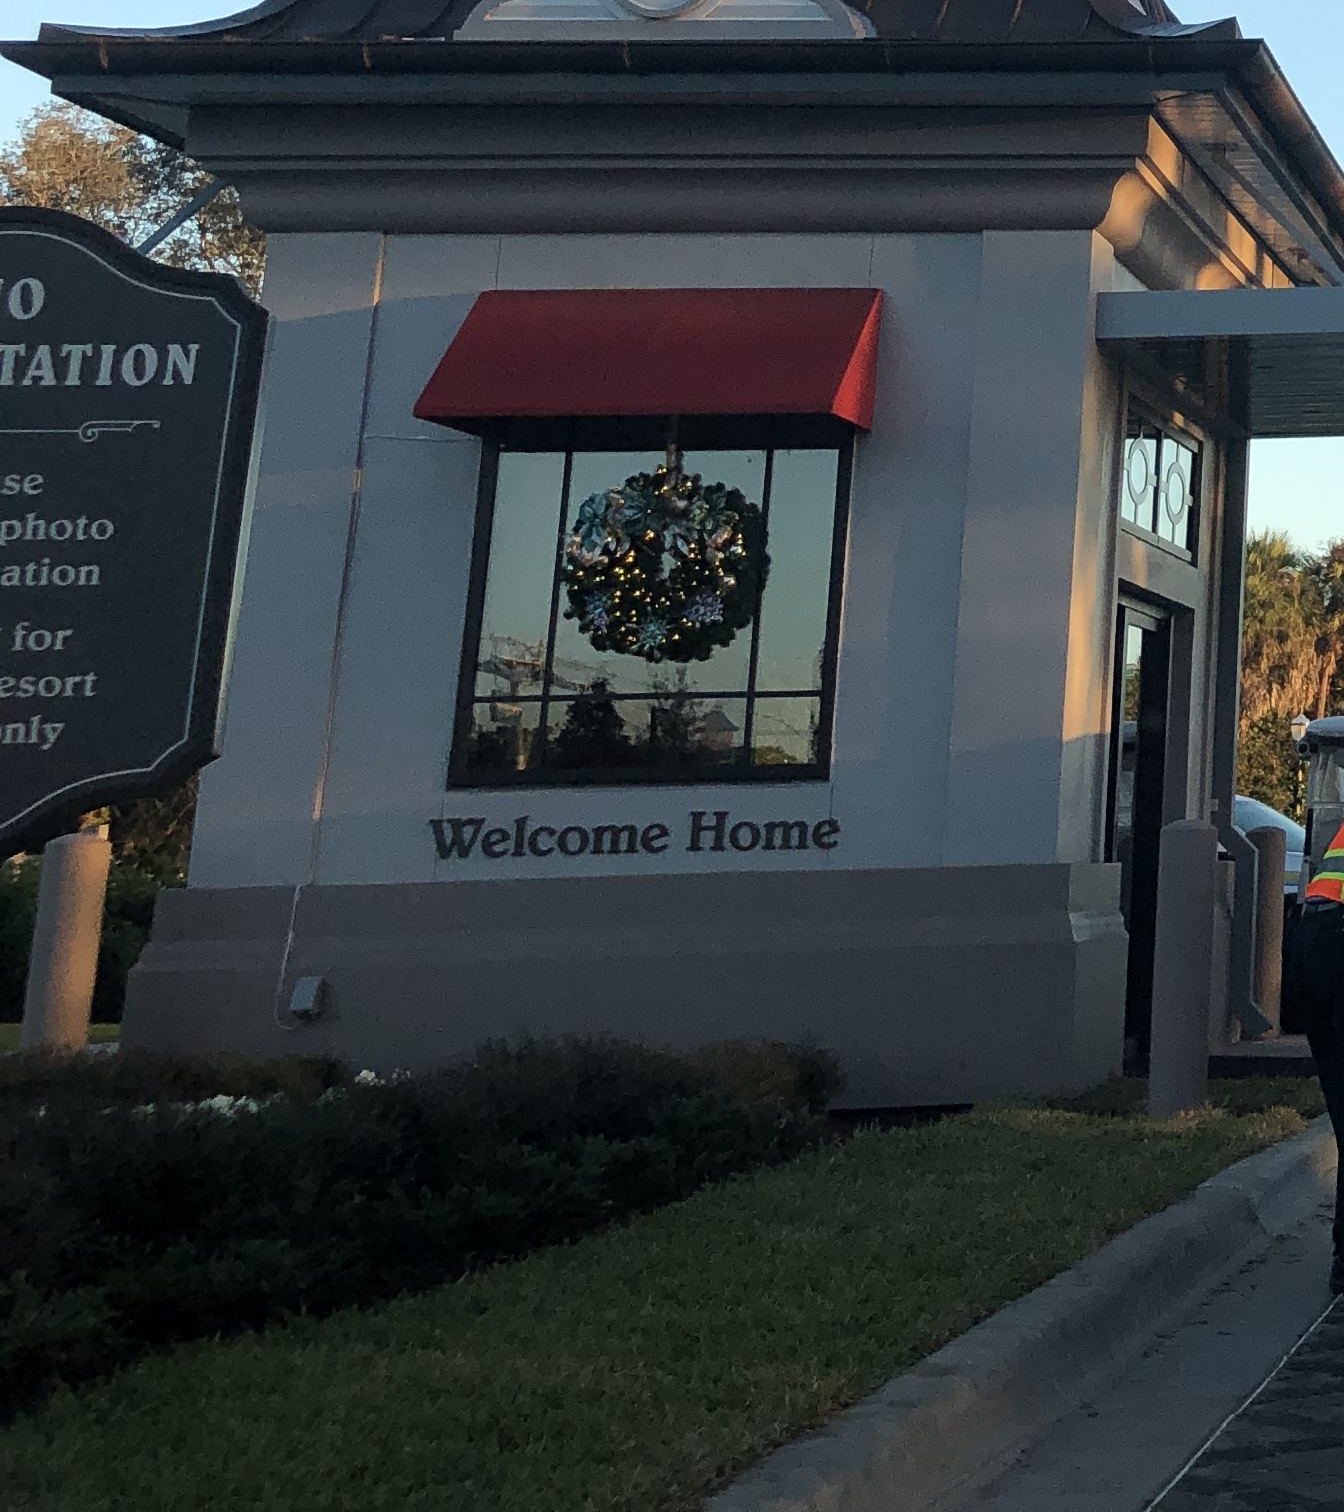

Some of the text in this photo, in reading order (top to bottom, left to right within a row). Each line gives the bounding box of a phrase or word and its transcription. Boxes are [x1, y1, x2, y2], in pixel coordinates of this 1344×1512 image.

[0, 277, 46, 320] O
[0, 343, 200, 387] TATION
[0, 511, 115, 546] photo
[0, 557, 101, 586] ation
[11, 621, 75, 651] for
[0, 672, 98, 698] esort
[0, 714, 66, 751] nly
[429, 811, 841, 860] Welcome Home
